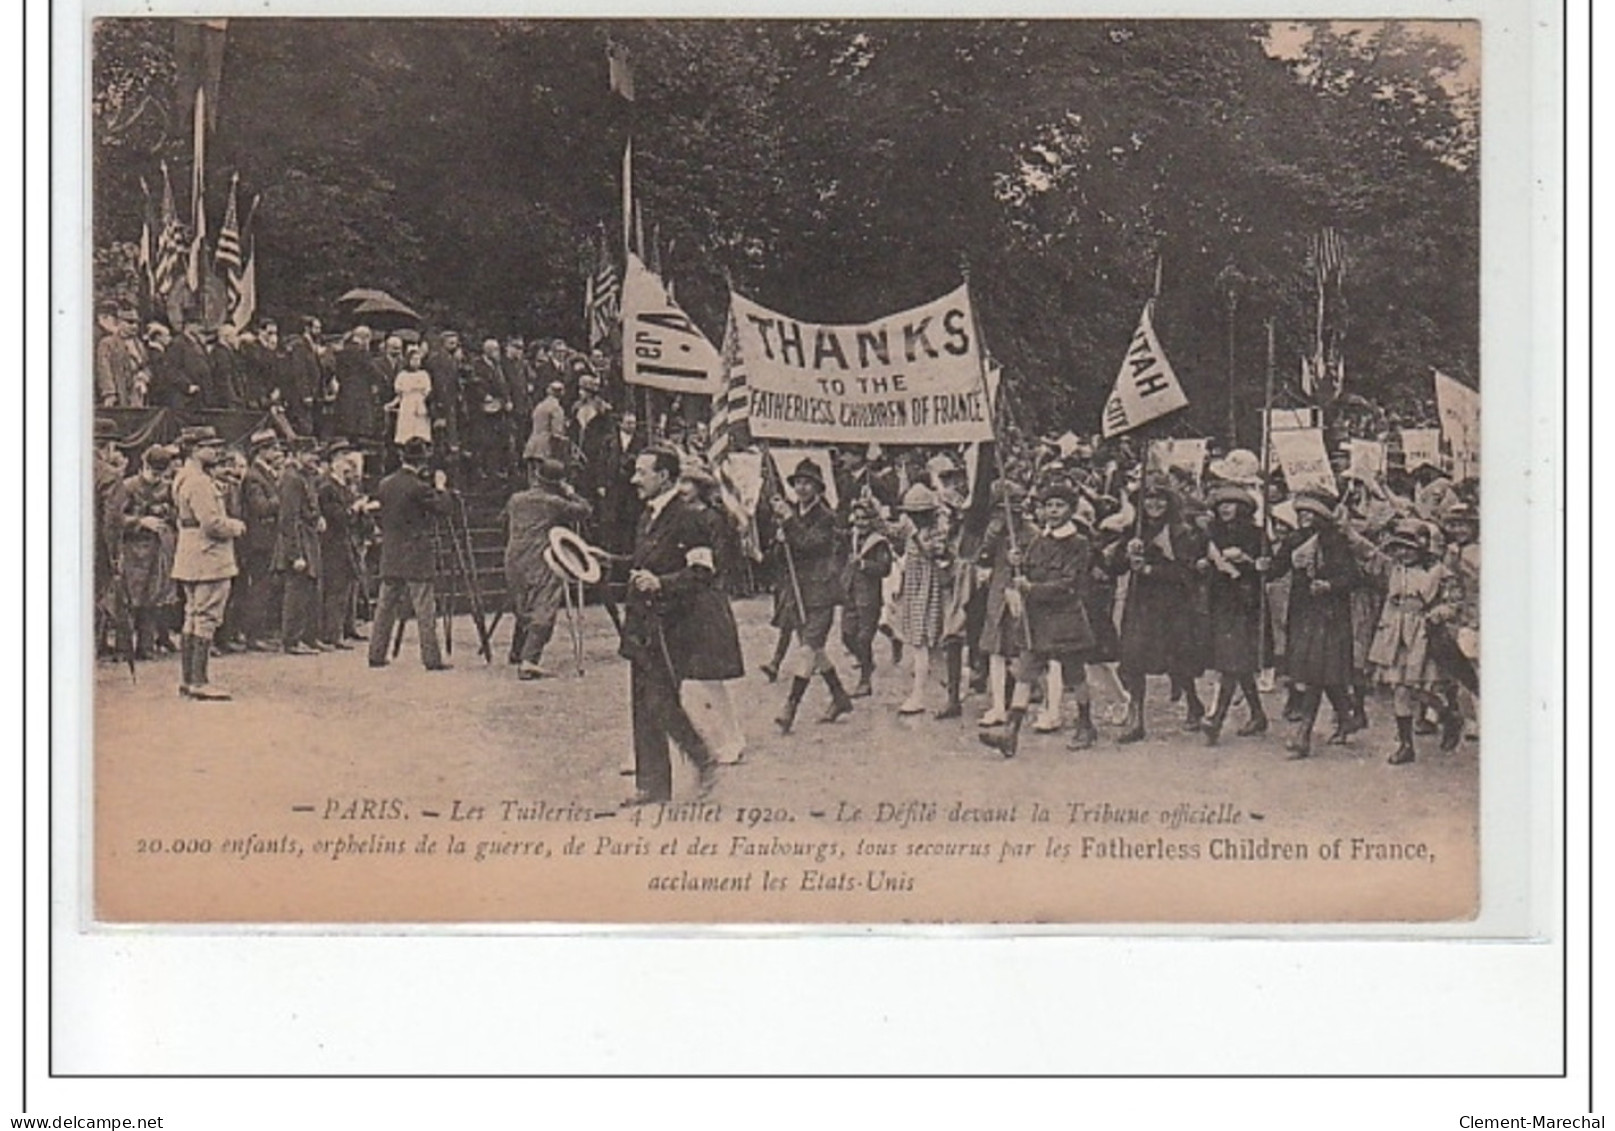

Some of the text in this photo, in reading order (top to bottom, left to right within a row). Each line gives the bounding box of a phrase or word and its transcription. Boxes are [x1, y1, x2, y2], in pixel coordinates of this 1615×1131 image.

[746, 309, 970, 369] THANKS
[817, 375, 907, 395] TO THE
[912, 396, 930, 425] OF
